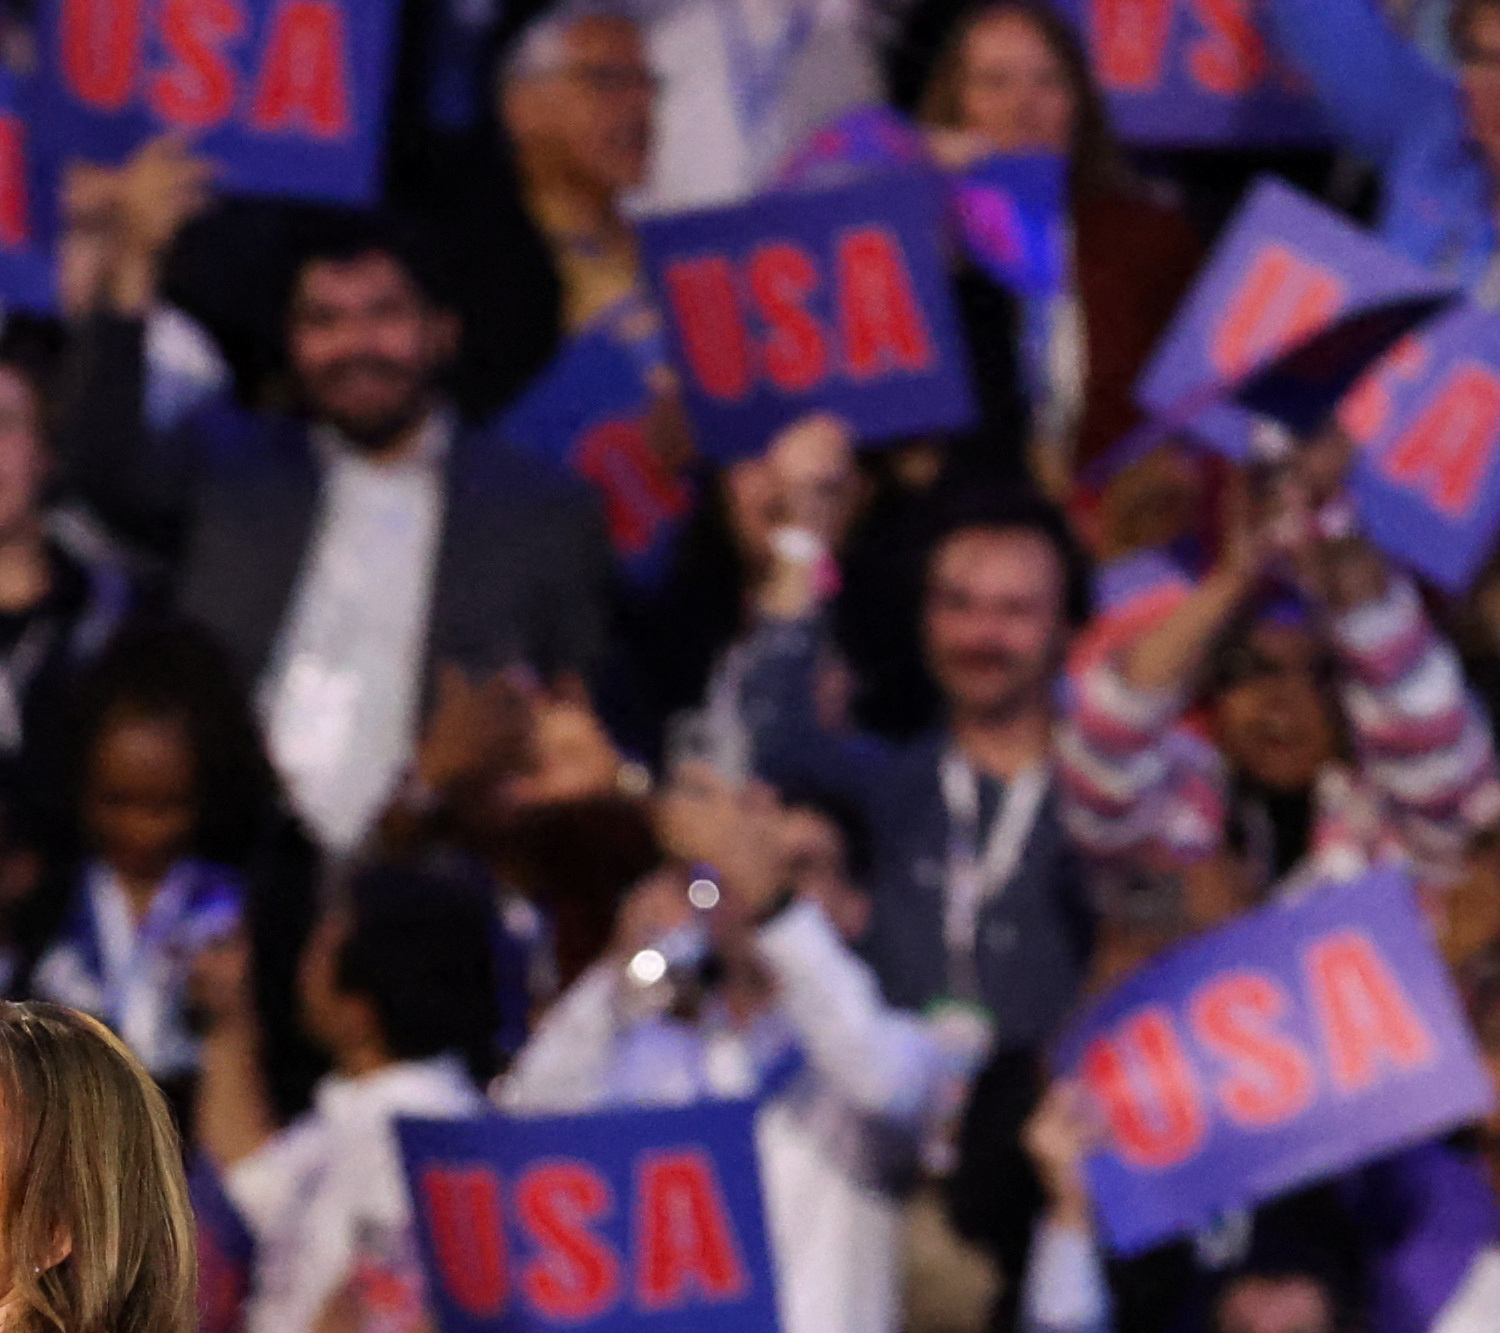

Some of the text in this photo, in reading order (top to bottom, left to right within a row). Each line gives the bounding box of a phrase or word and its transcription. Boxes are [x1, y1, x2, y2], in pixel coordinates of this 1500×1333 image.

[58, 0, 350, 138] USA
[1088, 0, 1266, 95] US
[665, 228, 932, 400] USA
[1082, 930, 1432, 1170] USA
[420, 1152, 750, 1320] USA
